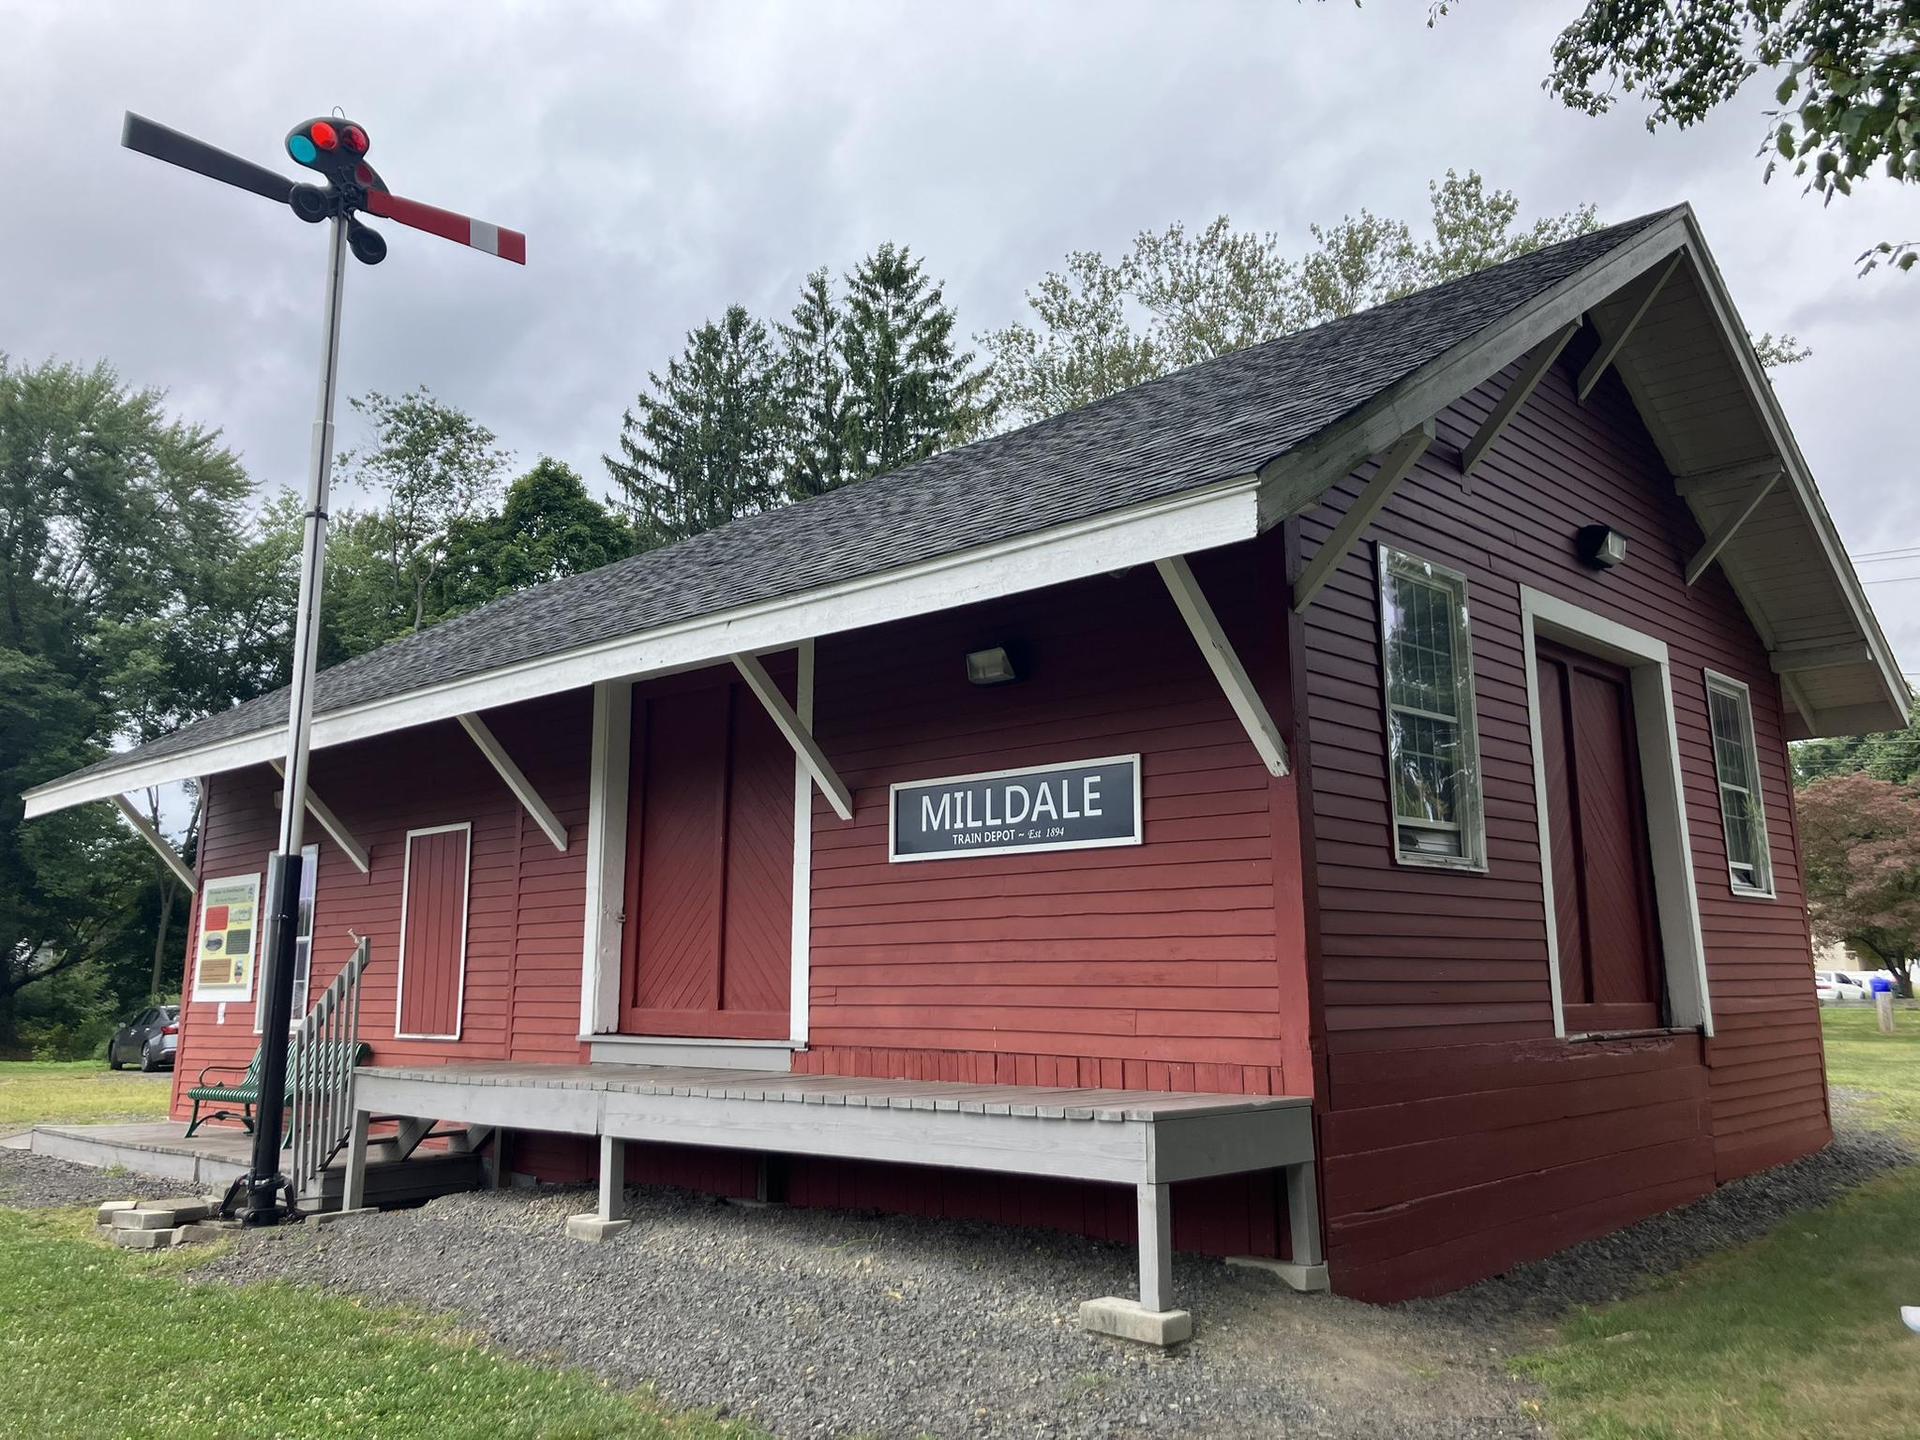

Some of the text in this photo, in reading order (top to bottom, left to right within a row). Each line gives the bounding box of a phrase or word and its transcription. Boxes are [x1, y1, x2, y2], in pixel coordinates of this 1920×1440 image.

[921, 775, 1103, 832] MILLDALE
[952, 832, 982, 845] TRAIN
[984, 829, 1016, 842] DEPOT
[1045, 827, 1065, 838] 1894
